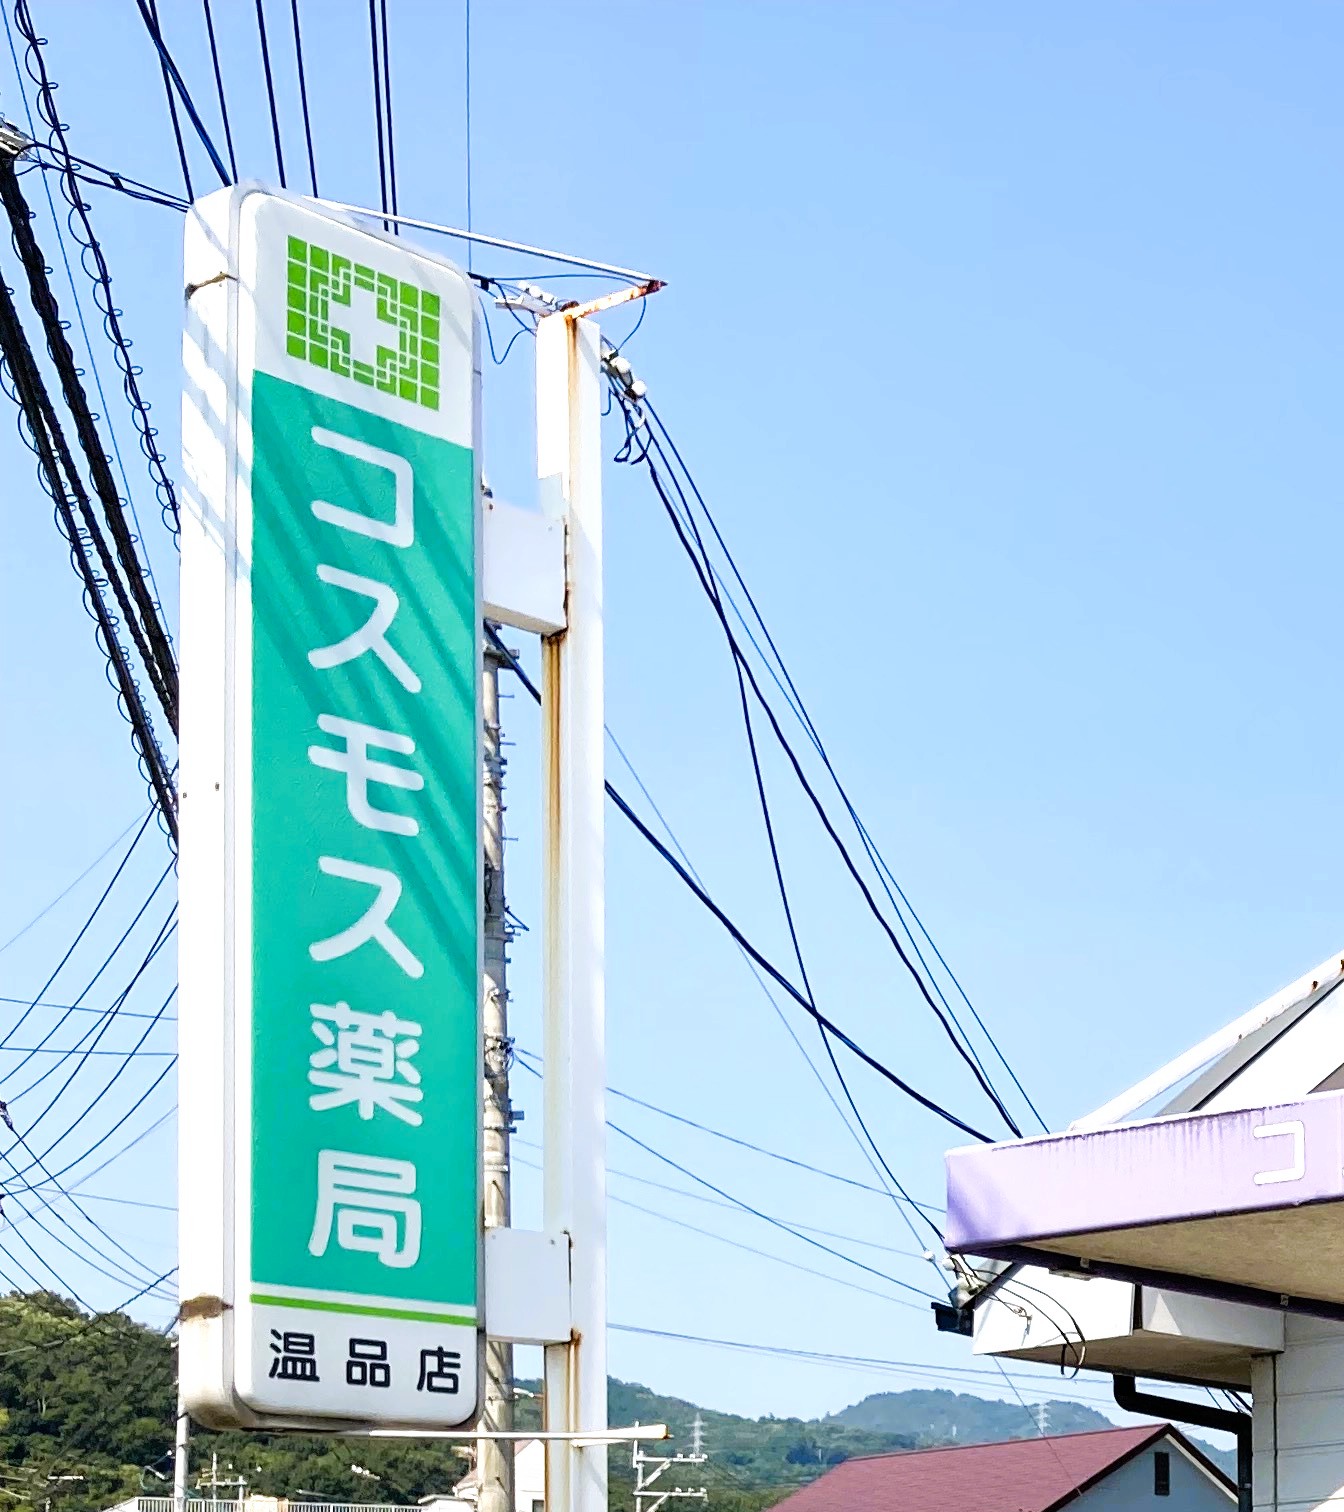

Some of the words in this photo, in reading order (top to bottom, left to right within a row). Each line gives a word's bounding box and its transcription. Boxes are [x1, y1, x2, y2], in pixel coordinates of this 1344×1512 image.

[308, 426, 424, 1269] コスモス薬局
[269, 1329, 460, 1395] 温品店
